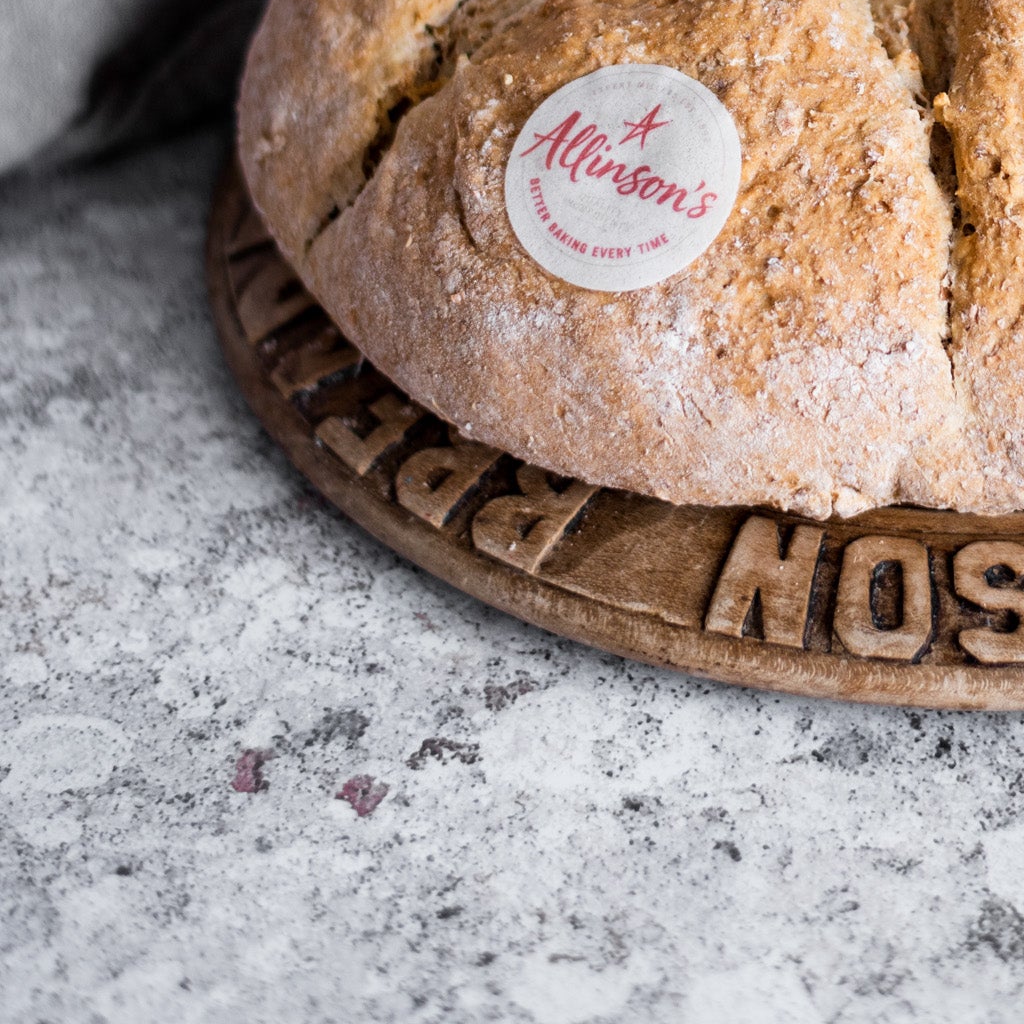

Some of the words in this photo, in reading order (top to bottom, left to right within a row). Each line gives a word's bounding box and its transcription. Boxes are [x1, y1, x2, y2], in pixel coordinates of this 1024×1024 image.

[519, 110, 718, 219] Allinson's
[529, 177, 551, 223] BETTER
[548, 222, 588, 254] BAKING
[591, 246, 632, 259] EVERY
[637, 233, 669, 254] TIME
